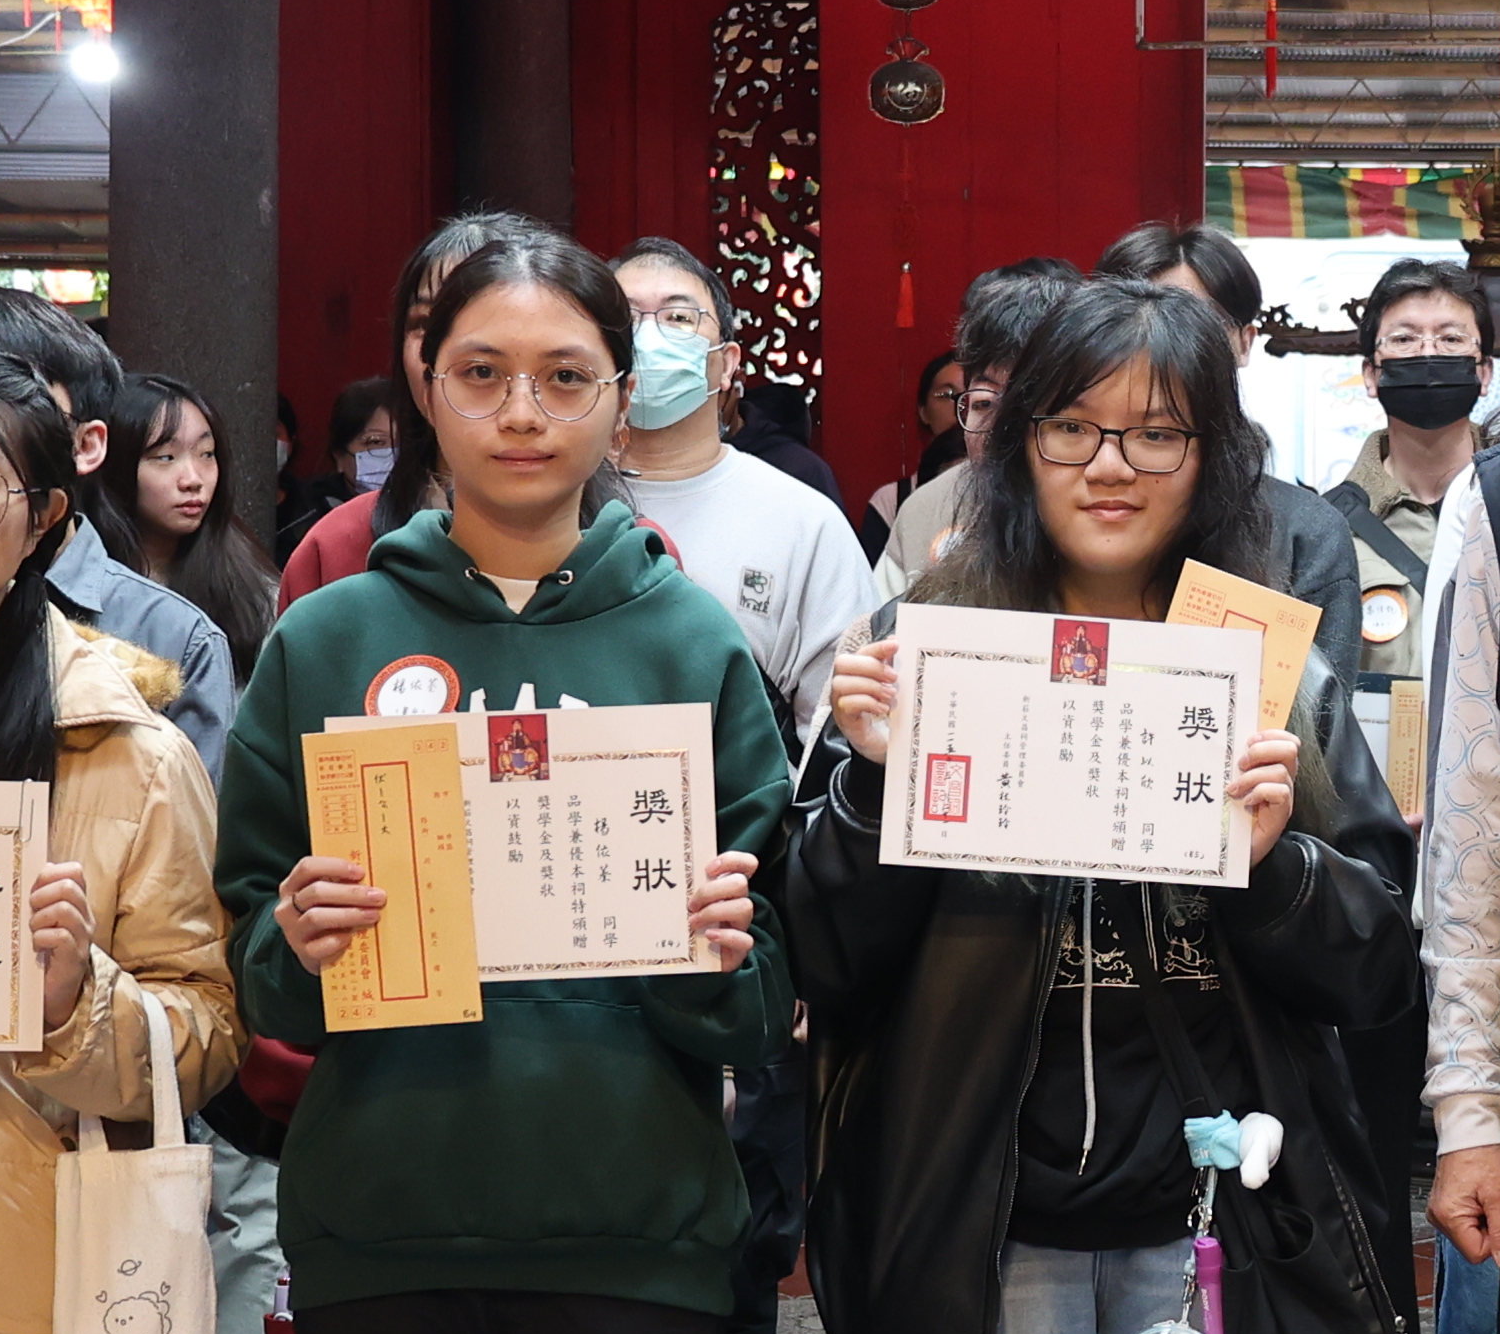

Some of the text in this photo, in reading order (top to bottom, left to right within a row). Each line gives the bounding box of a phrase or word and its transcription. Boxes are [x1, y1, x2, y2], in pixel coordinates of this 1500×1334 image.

[1059, 700, 1077, 763] 以資鼓勵
[1086, 700, 1105, 798] 獎學金及獎狀
[1111, 703, 1134, 852] 品學兼優本祠特頒贈
[1173, 706, 1219, 804] 獎狀
[506, 798, 524, 863] 以資鼓勵
[537, 795, 555, 898] 獎學金及獎狀
[567, 795, 588, 949] 品學兼優本祠特頒贈
[630, 789, 677, 892] 獎狀
[1140, 823, 1155, 853] 同學
[603, 916, 618, 948] 同學
[340, 1007, 373, 1018] 242
